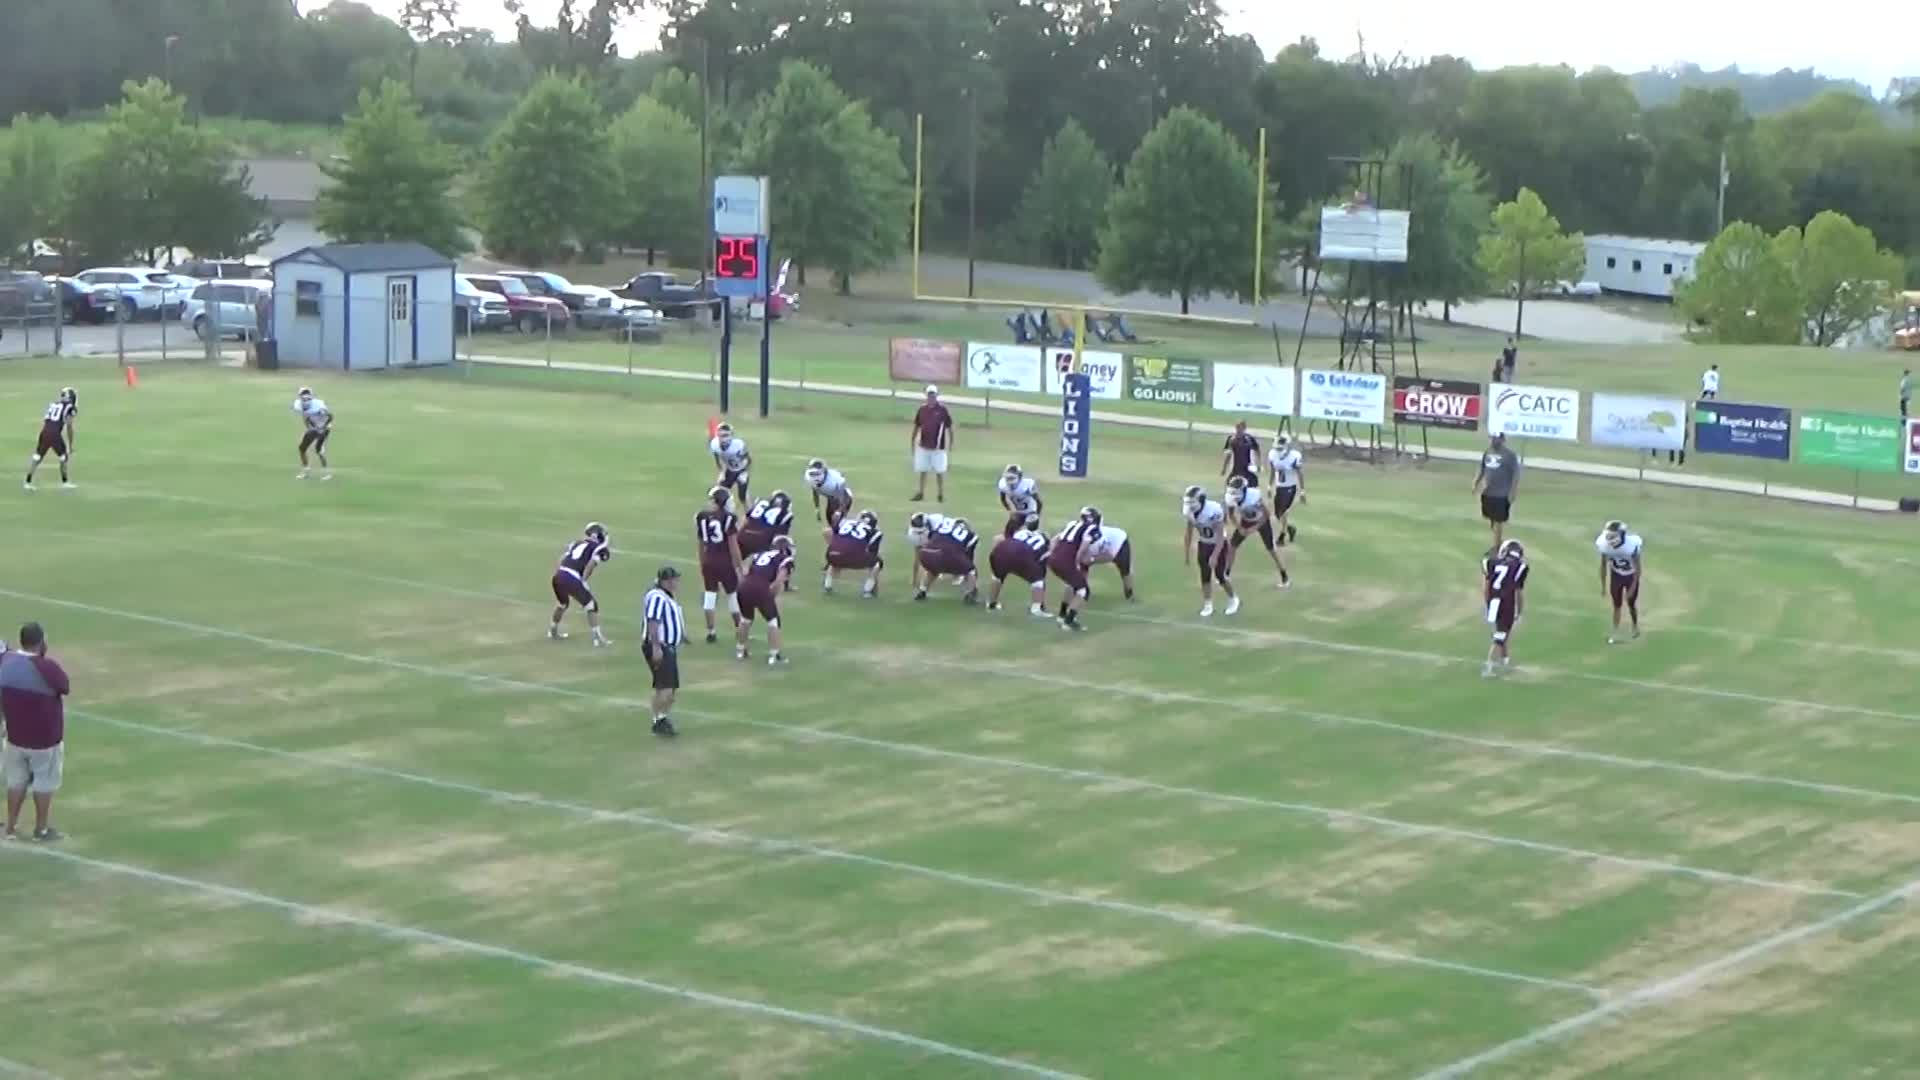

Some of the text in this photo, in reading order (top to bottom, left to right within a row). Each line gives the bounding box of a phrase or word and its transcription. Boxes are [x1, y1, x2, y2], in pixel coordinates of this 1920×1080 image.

[718, 236, 756, 278] 25
[1075, 362, 1117, 381] aney
[1133, 386, 1197, 404] GO LIONS!
[1404, 392, 1469, 417] CROW
[1519, 393, 1570, 414] CATC
[1062, 381, 1081, 472] LIONS
[750, 499, 782, 525] 64
[701, 517, 725, 544] 13
[838, 519, 872, 540] 65
[1492, 564, 1508, 590] 7
